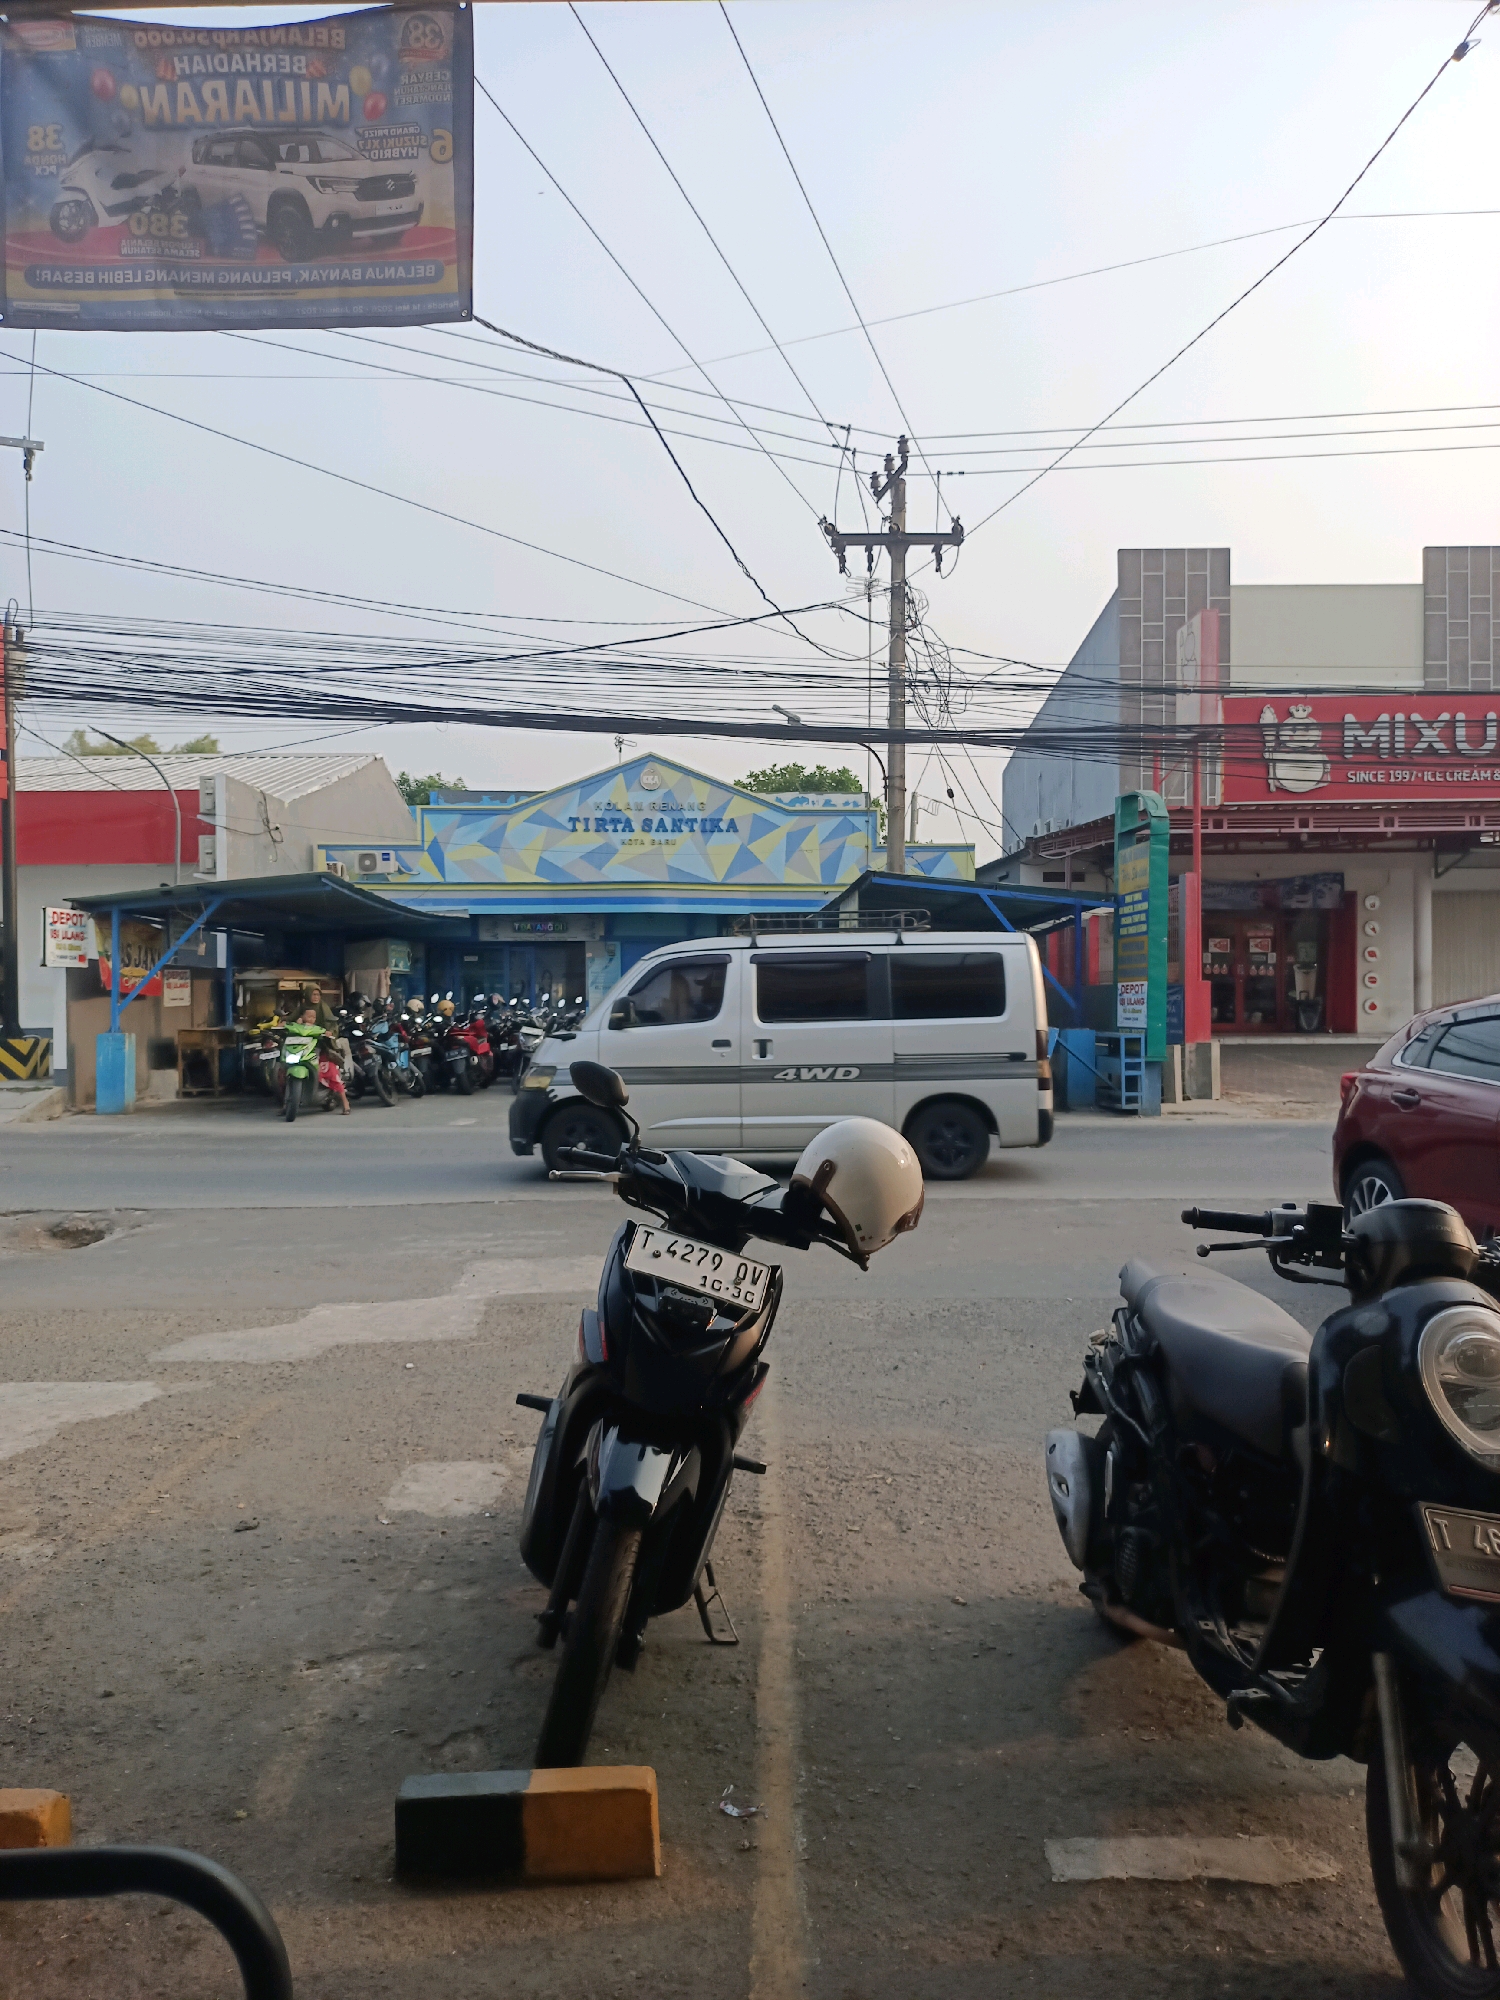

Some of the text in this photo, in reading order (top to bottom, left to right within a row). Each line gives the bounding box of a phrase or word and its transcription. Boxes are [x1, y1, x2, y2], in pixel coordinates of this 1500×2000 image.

[1347, 770, 1386, 783] SINCE
[1423, 769, 1445, 782] ICE
[1445, 767, 1491, 782] CREAM
[594, 801, 707, 811] KOLAM RENANG
[568, 817, 739, 833] TIRTA SANTIKA
[621, 838, 645, 846] KOTA
[51, 911, 85, 926] DEPOT
[61, 930, 85, 942] ULANG
[1121, 984, 1145, 994] DEPOT
[773, 1067, 861, 1081] 4WD
[642, 1230, 655, 1249] T
[666, 1240, 724, 1271] 4279
[1432, 1517, 1452, 1549] T
